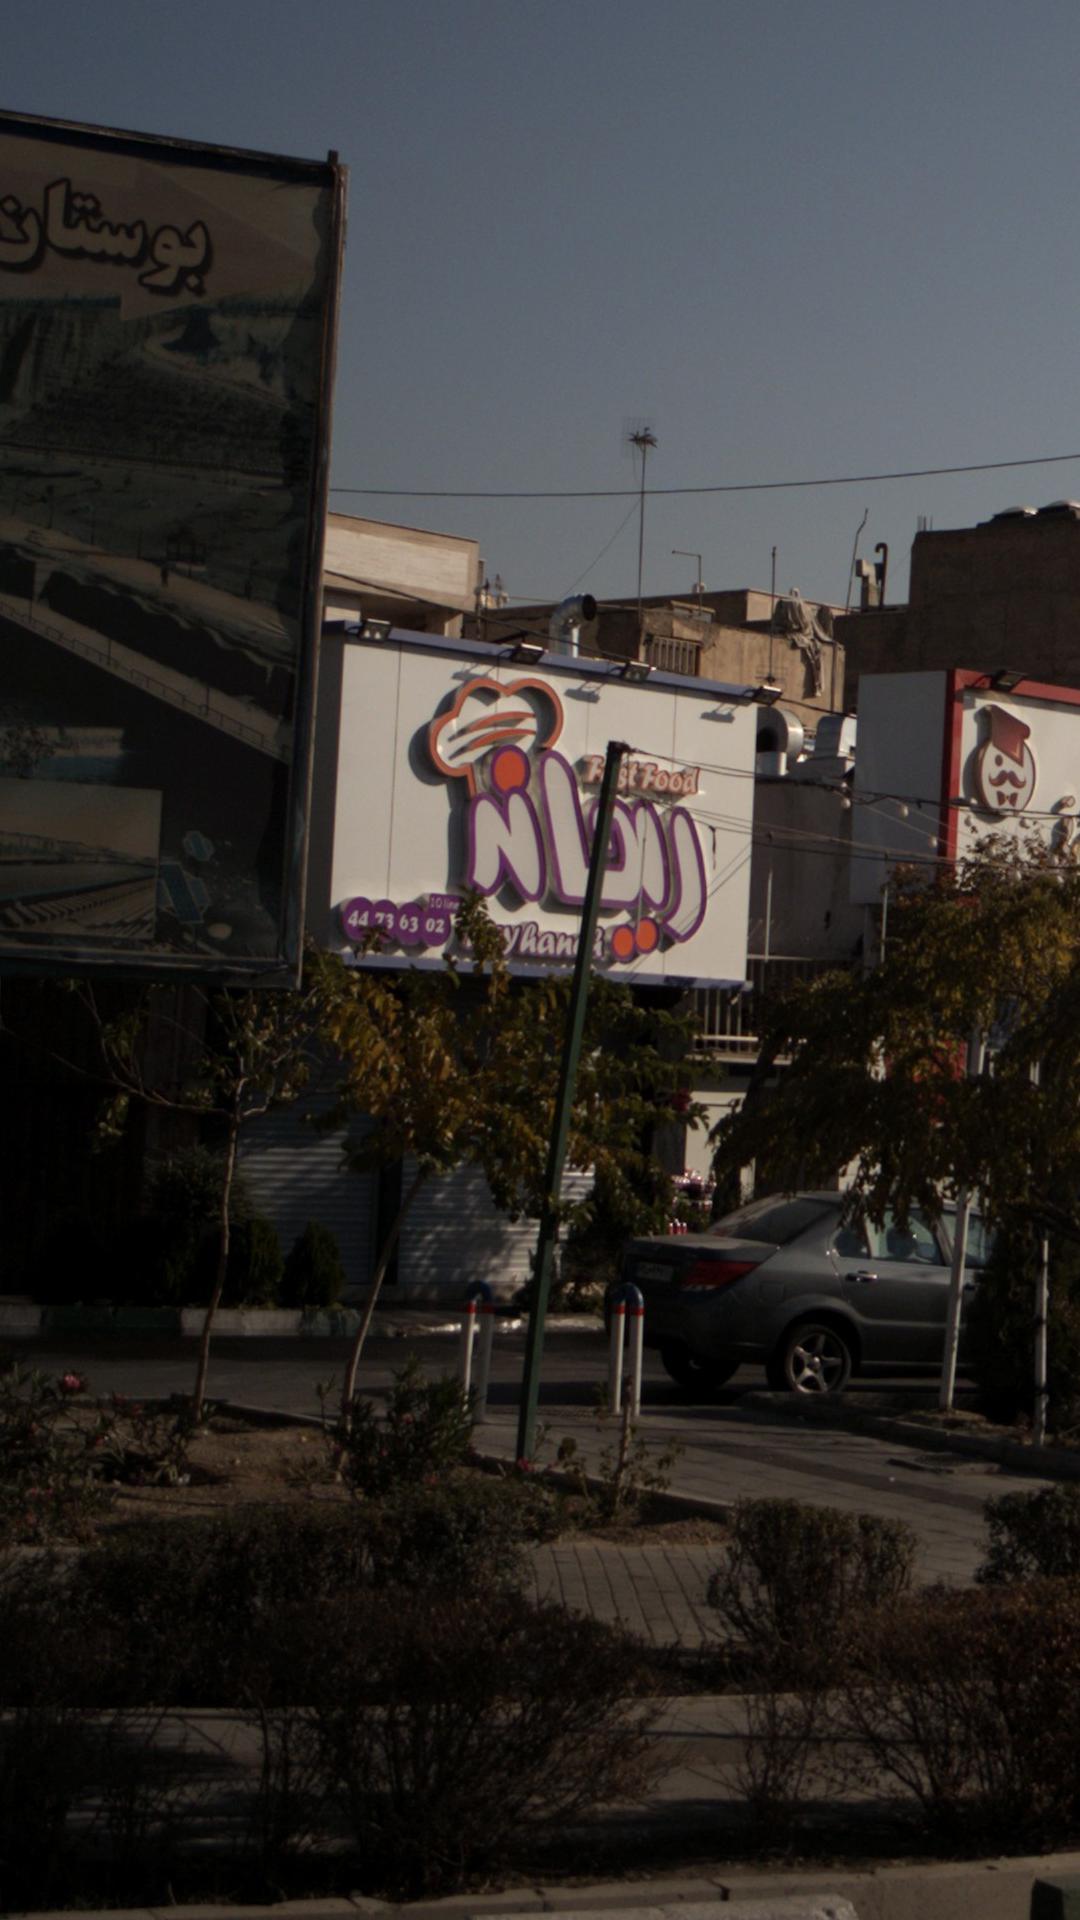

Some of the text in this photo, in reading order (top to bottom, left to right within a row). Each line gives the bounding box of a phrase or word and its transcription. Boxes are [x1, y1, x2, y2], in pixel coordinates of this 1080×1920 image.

[587, 754, 700, 795] Fst Food
[347, 909, 446, 934] 44 73 63 02
